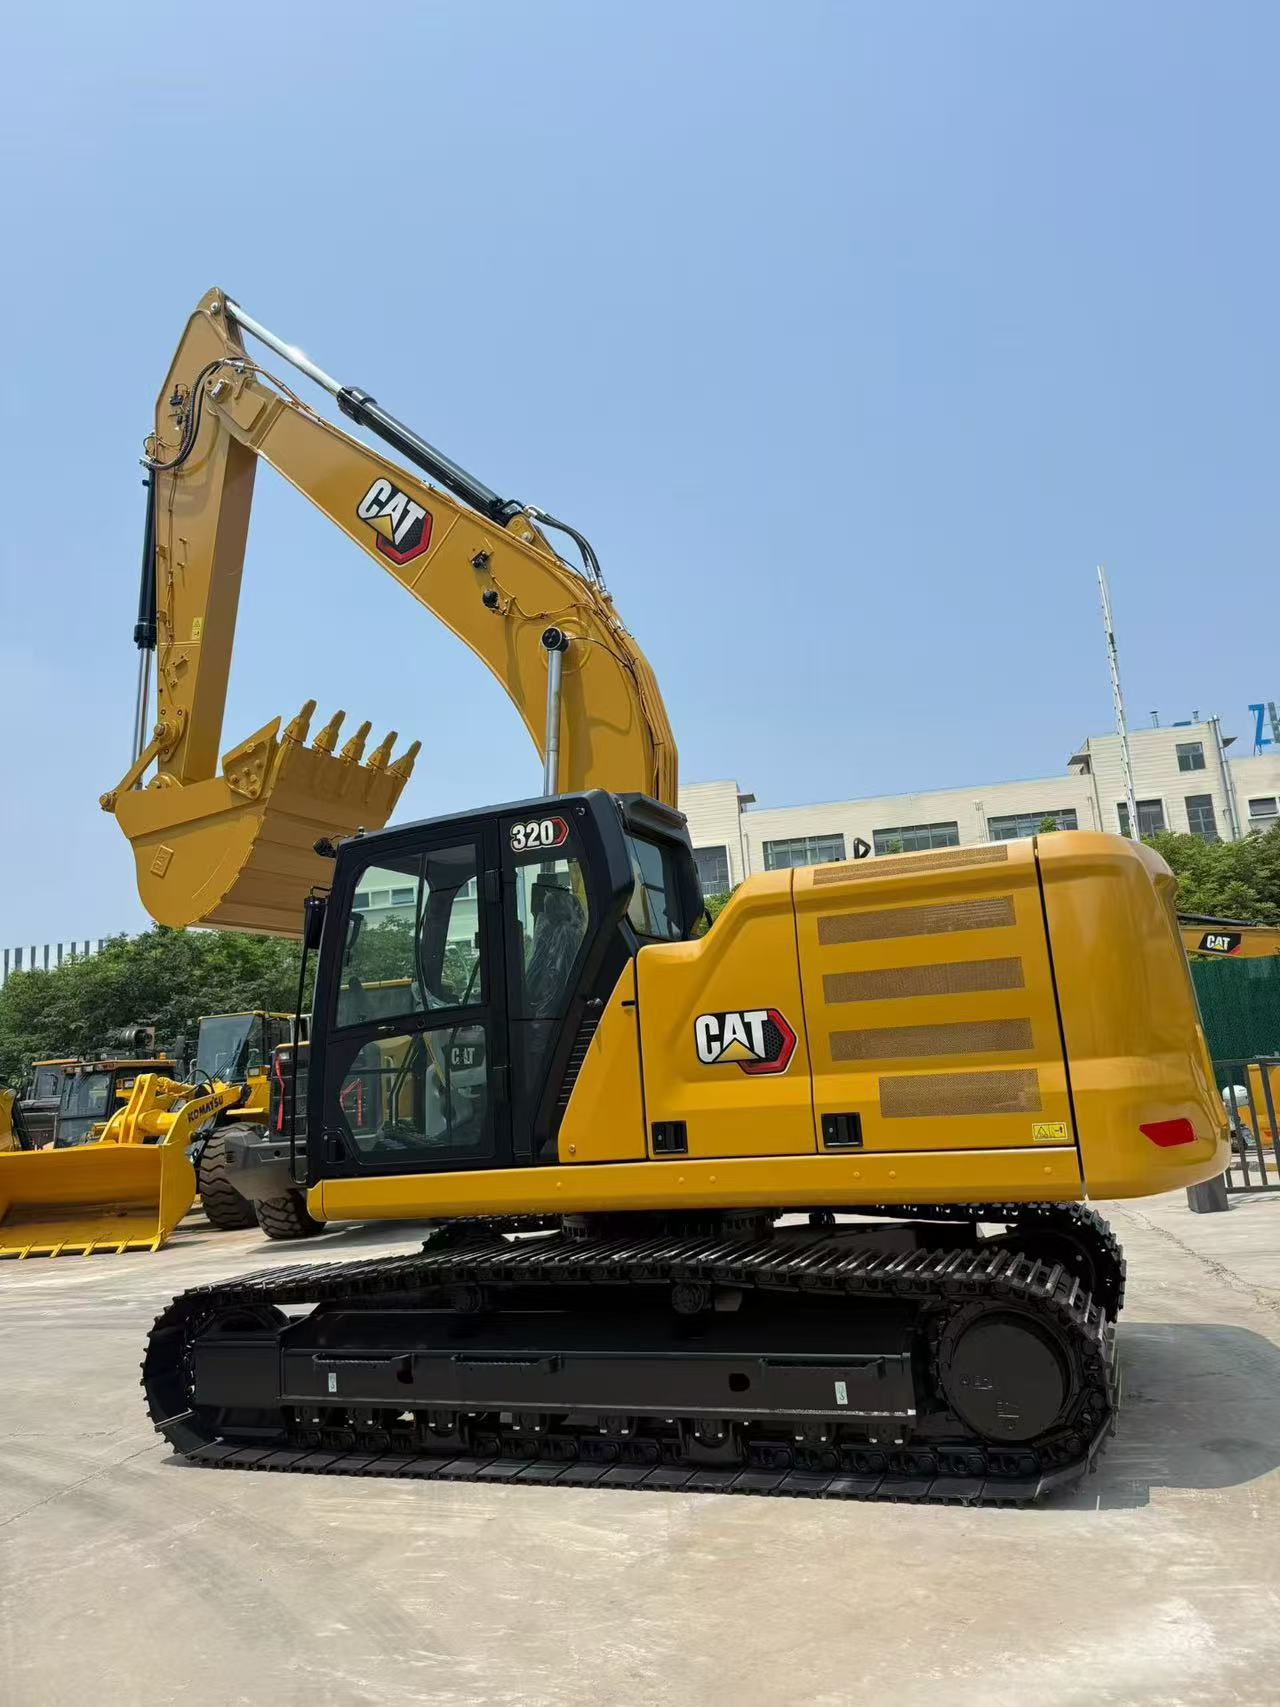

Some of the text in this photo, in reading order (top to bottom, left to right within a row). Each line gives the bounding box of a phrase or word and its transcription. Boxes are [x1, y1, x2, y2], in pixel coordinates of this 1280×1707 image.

[357, 478, 427, 546] CAT
[512, 820, 554, 849] 320
[1206, 935, 1231, 951] CAT
[695, 1010, 768, 1063] CAT
[187, 1095, 224, 1123] KOMATSU
